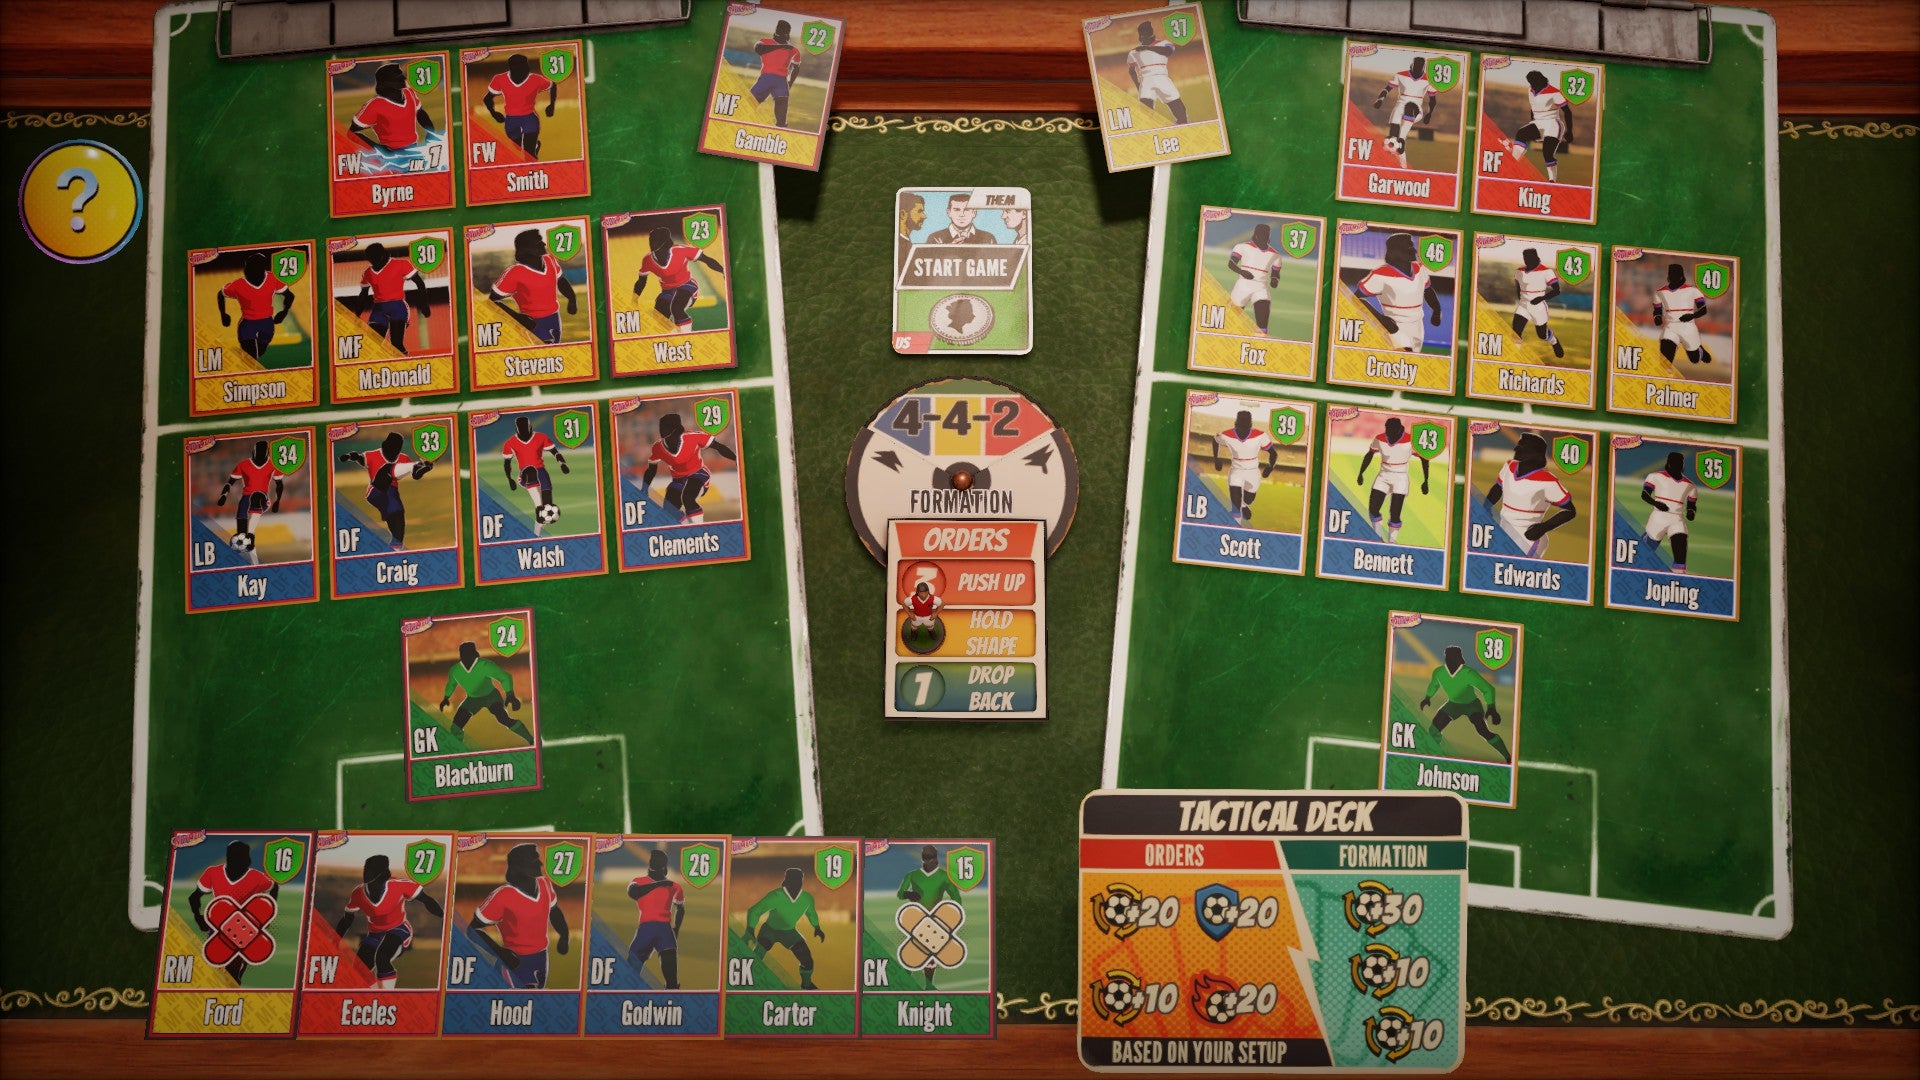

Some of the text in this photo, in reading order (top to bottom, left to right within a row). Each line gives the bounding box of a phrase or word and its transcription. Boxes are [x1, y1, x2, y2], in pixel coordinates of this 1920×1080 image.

[807, 28, 826, 47] 22
[1171, 19, 1187, 38] 37
[416, 67, 432, 86] 31
[550, 56, 564, 75] 31
[1434, 63, 1452, 83] 39
[1567, 76, 1586, 96] 32
[715, 93, 740, 115] MF
[1108, 107, 1132, 131] LM
[473, 142, 496, 163] FW
[735, 129, 787, 155] Gamble
[1154, 135, 1180, 155] Lee
[1348, 138, 1373, 160] FW
[338, 152, 362, 175] FW
[409, 145, 442, 172] LVL 1
[1483, 151, 1503, 173] RF
[507, 170, 548, 193] Smith
[1369, 173, 1430, 198] Garwood
[372, 184, 414, 208] Byrne
[985, 194, 1016, 206] THEM
[1518, 187, 1551, 214] King
[555, 232, 573, 252] 27
[691, 220, 709, 240] 23
[1289, 229, 1307, 249] 37
[417, 244, 436, 264] 30
[1426, 242, 1444, 262] 46
[280, 257, 298, 276] 29
[914, 258, 1007, 277] START GAME
[1564, 256, 1582, 276] 43
[1702, 269, 1721, 289] 40
[616, 310, 640, 334] RM
[1201, 304, 1225, 329] LM
[478, 322, 502, 347] MF
[1339, 318, 1364, 343] MF
[338, 335, 363, 359] MF
[653, 341, 692, 363] West
[1240, 343, 1266, 366] Fox
[1478, 332, 1503, 356] RM
[198, 347, 222, 372] LM
[504, 355, 563, 377] Stevens
[1617, 346, 1642, 370] MF
[359, 363, 431, 390] McDonald
[1366, 356, 1417, 385] Crosby
[1499, 368, 1565, 395] Richards
[223, 380, 286, 405] Simpson
[1646, 384, 1699, 409] Palmer
[702, 405, 722, 426] 29
[892, 399, 1020, 437] 4-4-2
[1278, 415, 1296, 436] 39
[564, 419, 580, 439] 31
[1418, 430, 1437, 450] 43
[421, 432, 440, 452] 33
[1561, 444, 1579, 464] 40
[279, 445, 297, 466] 34
[1704, 458, 1723, 479] 35
[625, 501, 647, 525] DF
[910, 490, 1013, 514] FORMATION
[1187, 495, 1208, 519] LB
[483, 514, 504, 539] DF
[1329, 509, 1351, 534] DF
[339, 528, 361, 552] DF
[649, 532, 720, 558] Clements
[923, 527, 1010, 552] ORDERS
[1220, 534, 1262, 560] Scott
[1472, 524, 1494, 548] DF
[194, 541, 215, 567] LB
[517, 545, 565, 570] Walsh
[1353, 548, 1414, 575] Bennett
[1616, 539, 1638, 564] DF
[376, 560, 418, 586] Craig
[958, 573, 1025, 591] PUSH UP
[1494, 563, 1561, 591] Edwards
[237, 575, 267, 600] Kay
[1645, 578, 1699, 610] Jopling
[970, 610, 1013, 629] HOLD
[497, 626, 517, 648] 24
[966, 637, 1018, 654] SHAPE
[1484, 638, 1503, 660] 38
[968, 666, 1015, 684] DROP
[915, 672, 933, 706] 1
[969, 692, 1015, 711] BACK
[414, 726, 438, 753] GK
[1392, 722, 1416, 749] GK
[435, 761, 513, 788] Blackburn
[1417, 763, 1479, 792] Johnson
[1179, 800, 1378, 833] TACTICAL DECK
[275, 848, 292, 872] 16
[414, 849, 436, 874] 27
[553, 852, 574, 875] 27
[689, 853, 710, 877] 26
[825, 855, 842, 879] 19
[1145, 844, 1205, 867] ORDERS
[1339, 844, 1428, 868] FORMATION
[957, 856, 974, 880] 15
[1125, 896, 1180, 928] +20
[1226, 896, 1279, 928] +20
[1368, 893, 1424, 926] +30
[163, 955, 194, 983] RM
[308, 956, 339, 984] FW
[451, 956, 477, 984] DF
[591, 958, 615, 985] DF
[728, 958, 754, 986] GK
[864, 959, 889, 987] GK
[1385, 956, 1430, 988] +10
[1132, 982, 1179, 1014] +10
[1225, 982, 1278, 1015] +20
[203, 999, 244, 1026] Ford
[341, 999, 397, 1026] Eccles
[490, 999, 532, 1026] Hood
[621, 1000, 682, 1026] Godwin
[763, 1001, 817, 1027] Carter
[897, 1001, 952, 1033] Knight
[1399, 1019, 1444, 1050] +10
[1112, 1041, 1287, 1063] BASED ON YOUR SETUP
